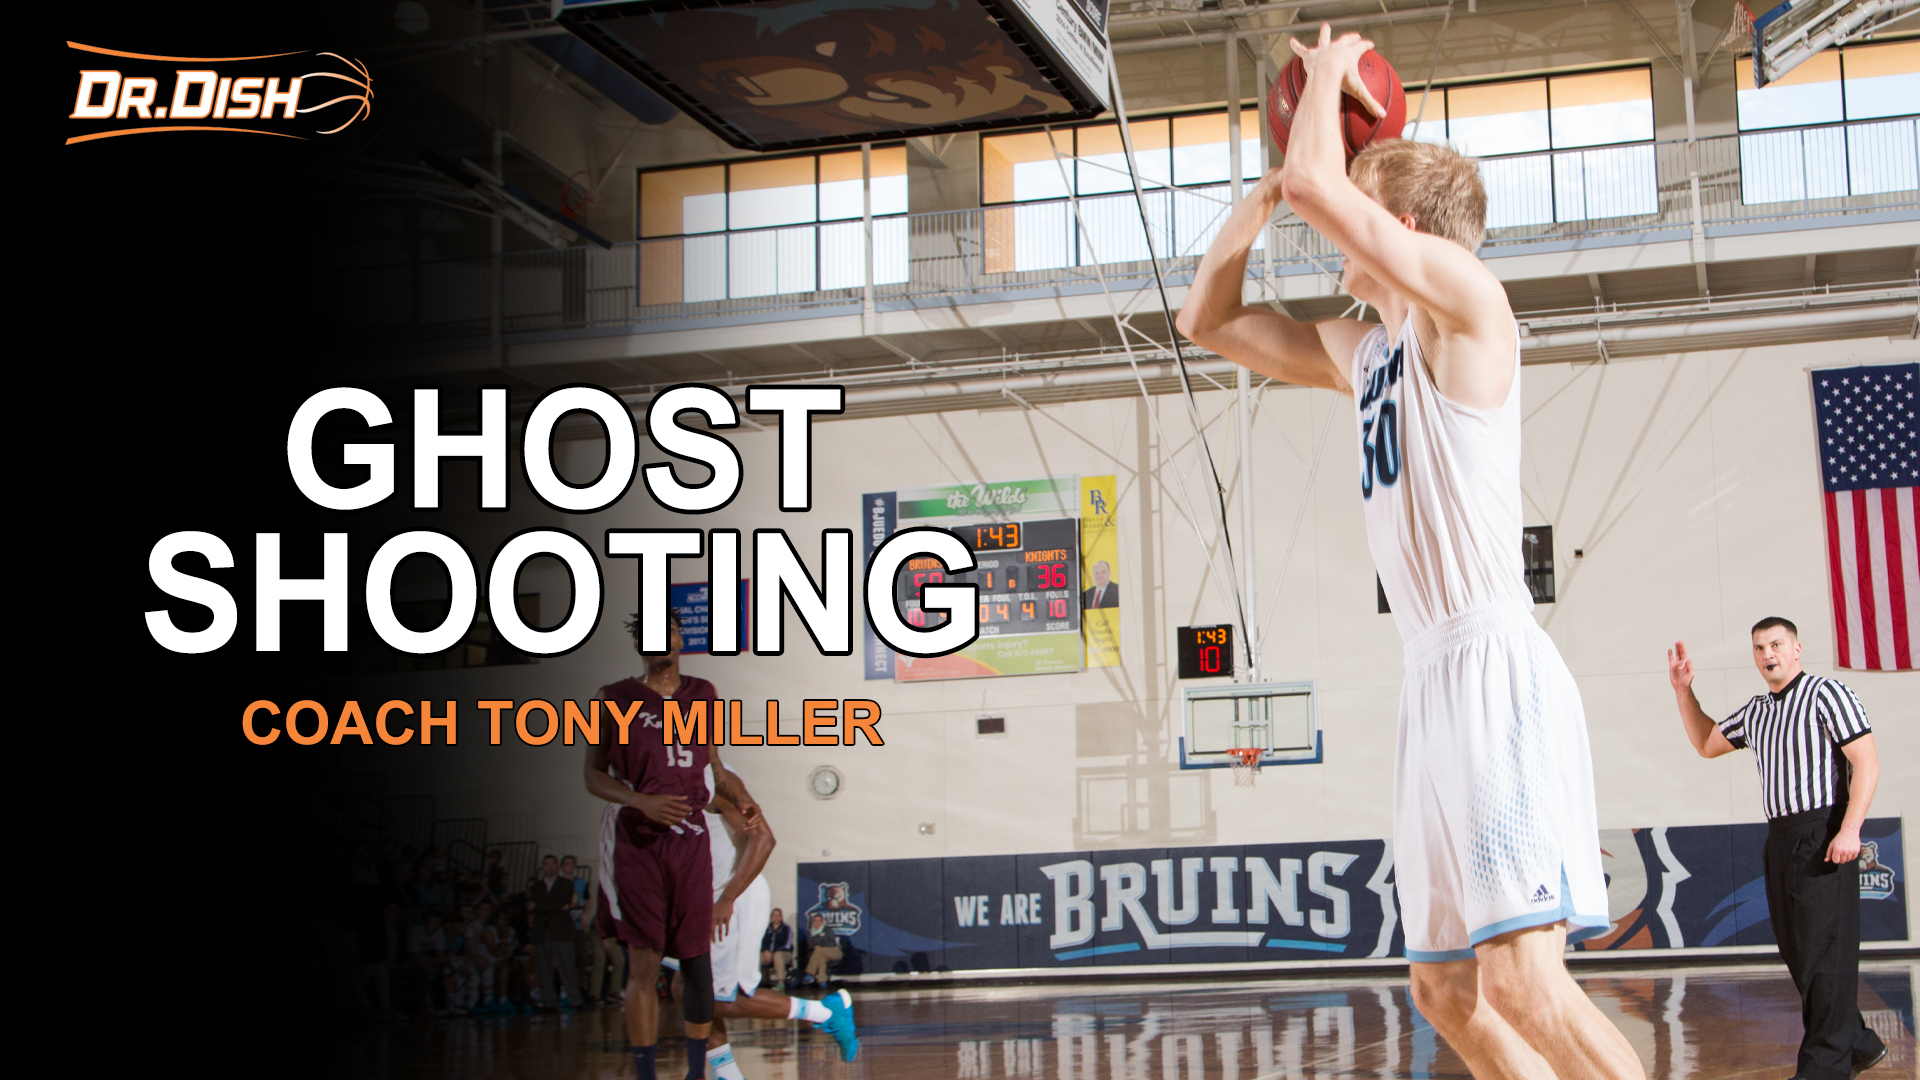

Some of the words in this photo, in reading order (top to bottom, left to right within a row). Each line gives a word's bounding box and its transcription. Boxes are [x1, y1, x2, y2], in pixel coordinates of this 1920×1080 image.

[946, 490, 970, 509] the
[970, 482, 1027, 508] Wilds
[977, 524, 1018, 549] 1:43
[978, 560, 999, 569] ERIOD
[1025, 549, 1067, 563] KNIGHTS
[1038, 563, 1066, 588] 36
[992, 594, 1011, 602] FOUL
[1046, 591, 1069, 599] FOULS
[1049, 599, 1066, 618] 10
[980, 626, 1000, 635] ATCH
[1046, 622, 1070, 631] SCORE
[1197, 628, 1226, 645] 1:43
[1200, 645, 1220, 673] 10
[666, 740, 693, 767] 15
[1860, 873, 1890, 888] INS
[954, 895, 990, 928] WE
[1000, 892, 1042, 926] ARE
[1039, 851, 1360, 950] BRUINS
